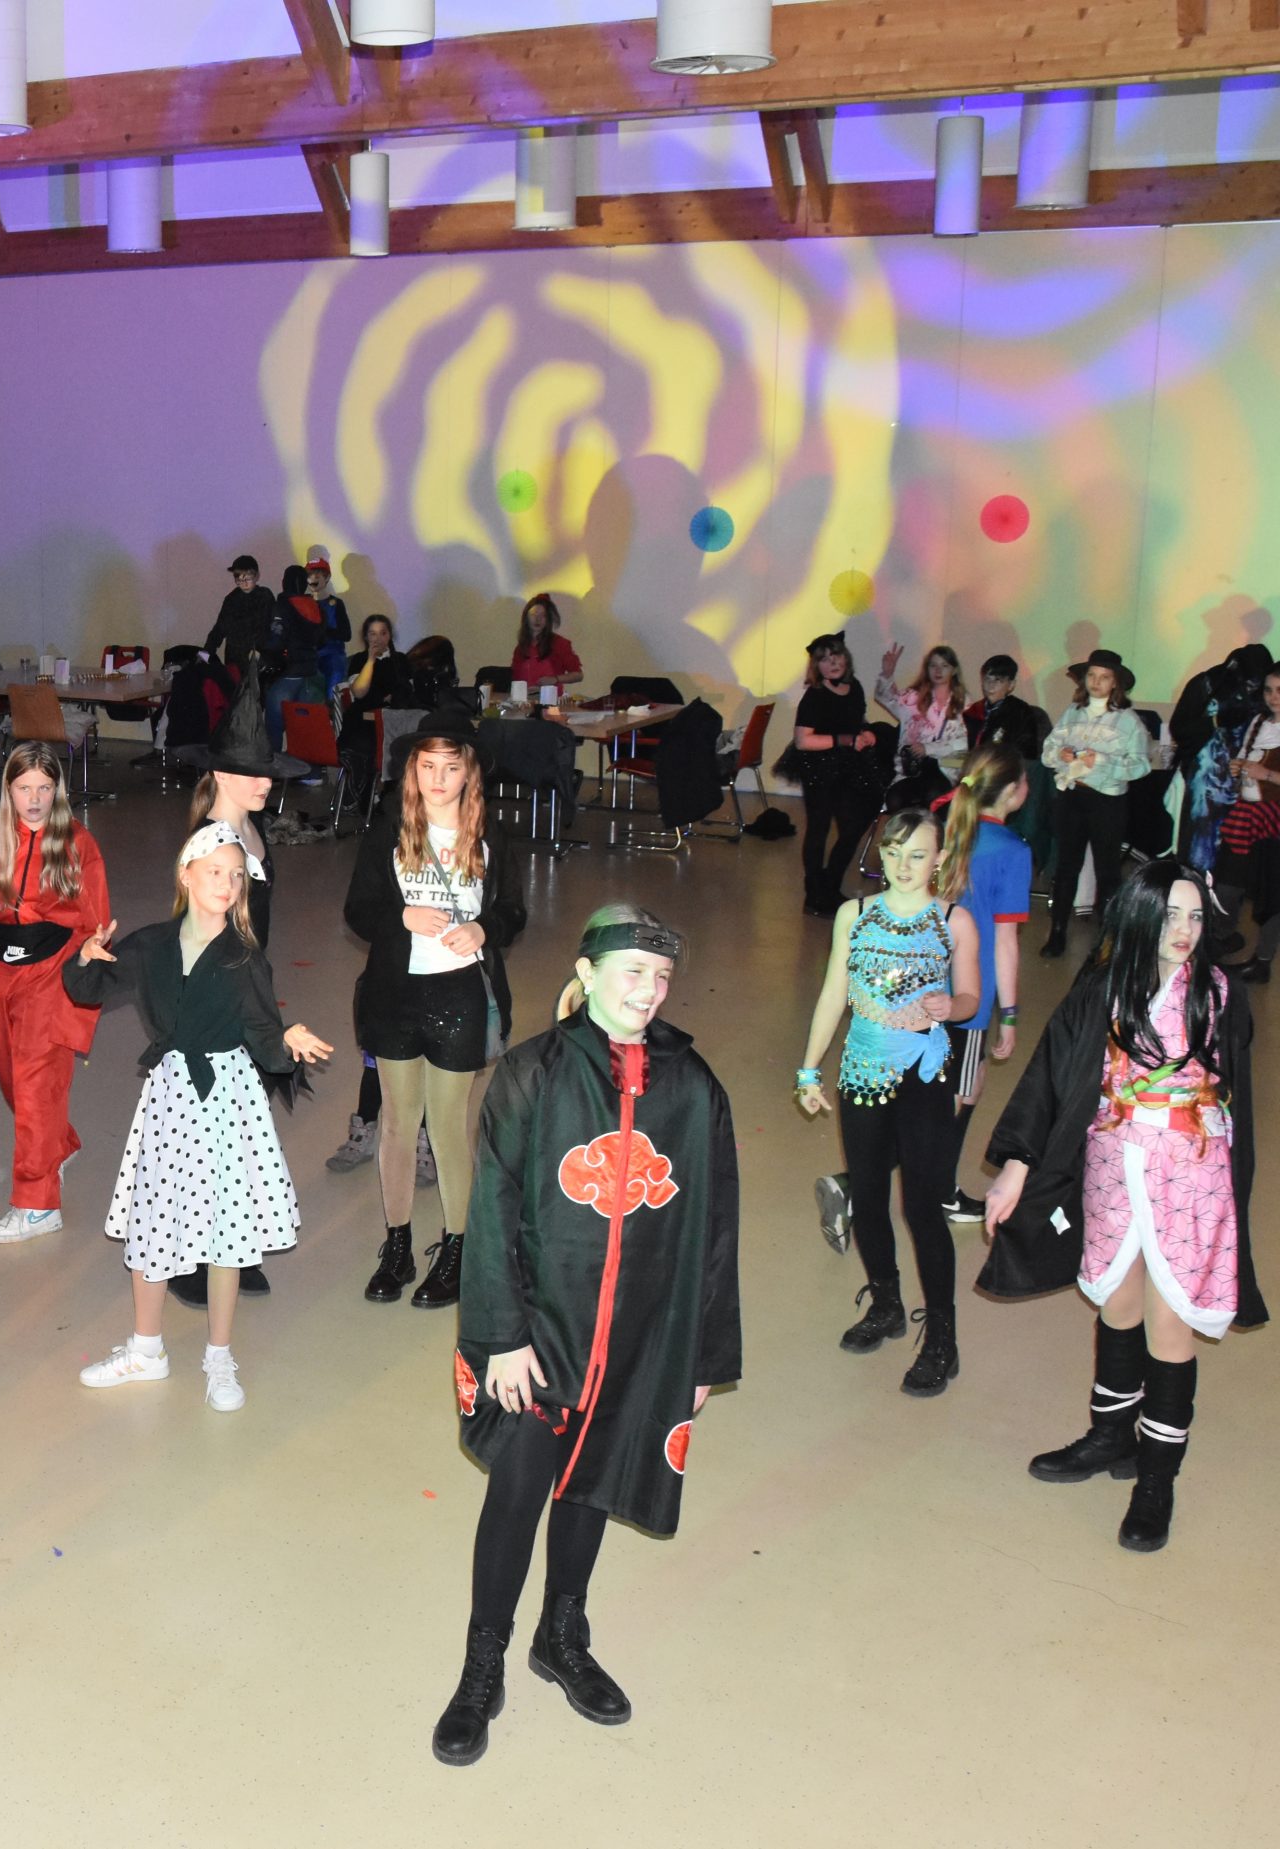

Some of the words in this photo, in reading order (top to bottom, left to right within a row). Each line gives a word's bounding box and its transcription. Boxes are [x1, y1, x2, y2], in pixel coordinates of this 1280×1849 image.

[405, 890, 423, 900] AT
[429, 891, 460, 903] THE
[7, 945, 26, 956] NIKE
